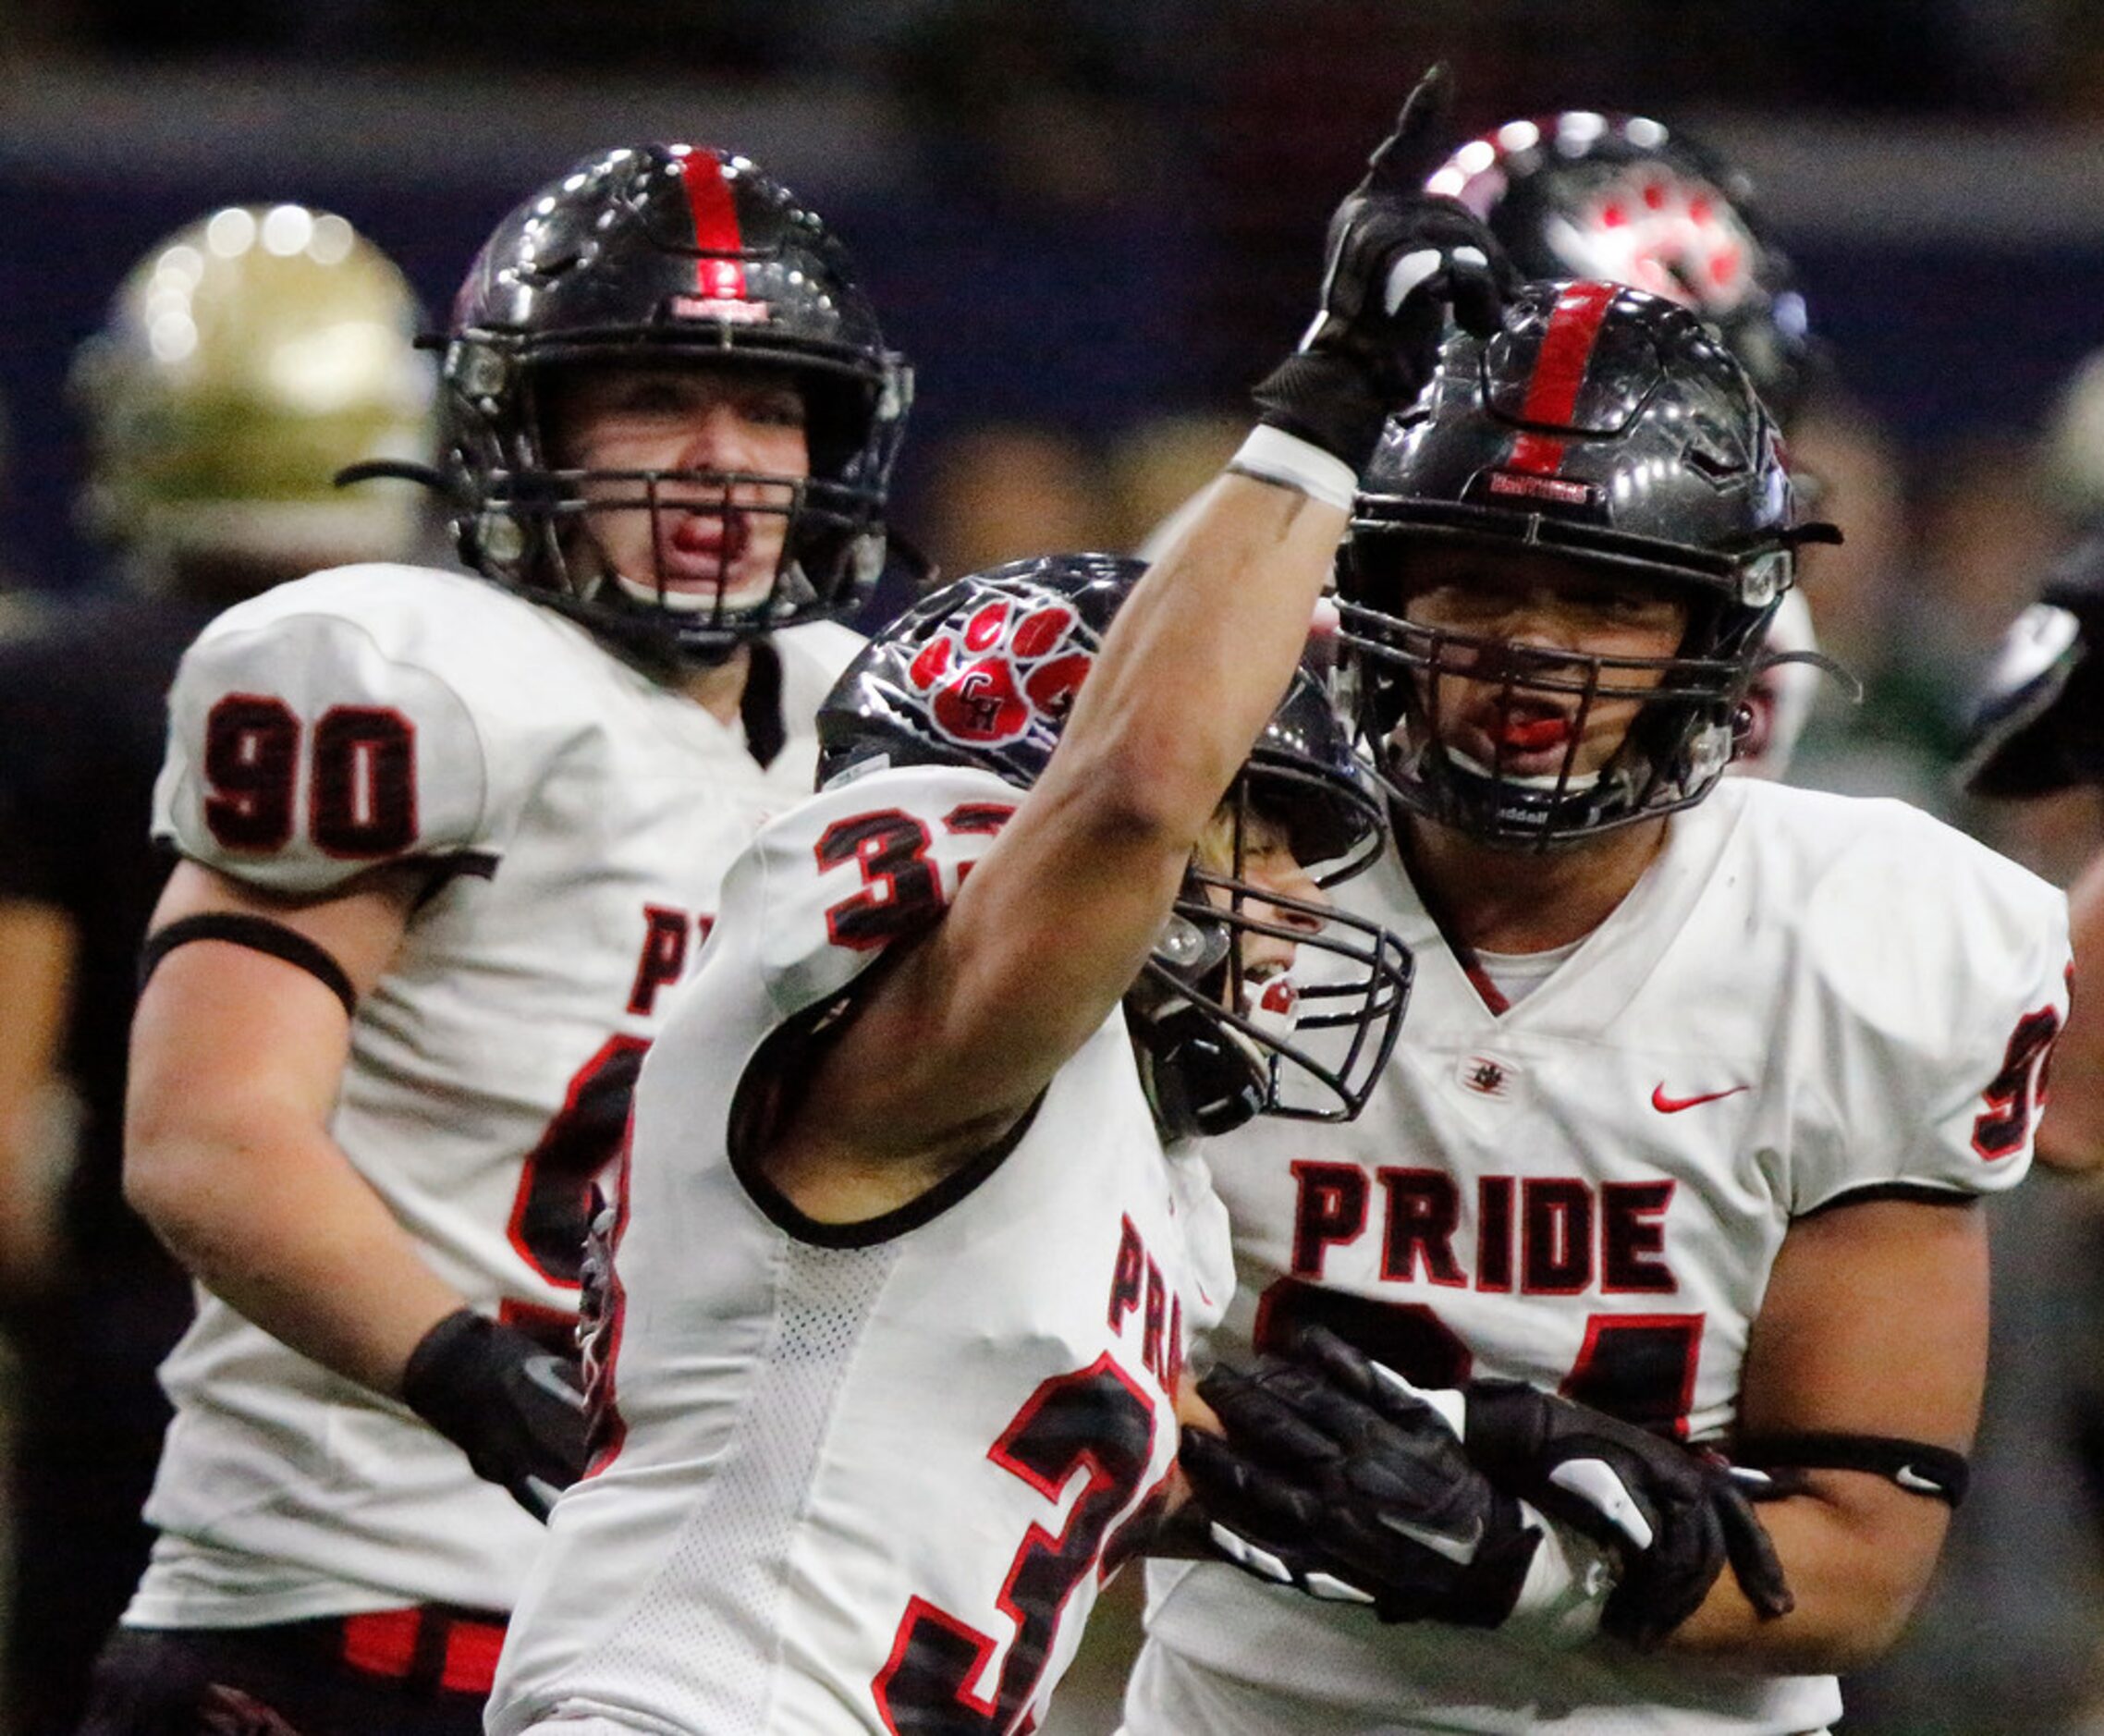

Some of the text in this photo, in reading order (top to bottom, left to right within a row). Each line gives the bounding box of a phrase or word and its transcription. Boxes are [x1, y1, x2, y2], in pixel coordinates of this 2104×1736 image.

[204, 691, 420, 860] 90
[625, 902, 716, 1016] P
[1971, 1004, 2060, 1162] 9
[1291, 1160, 1679, 1296] PRIDE
